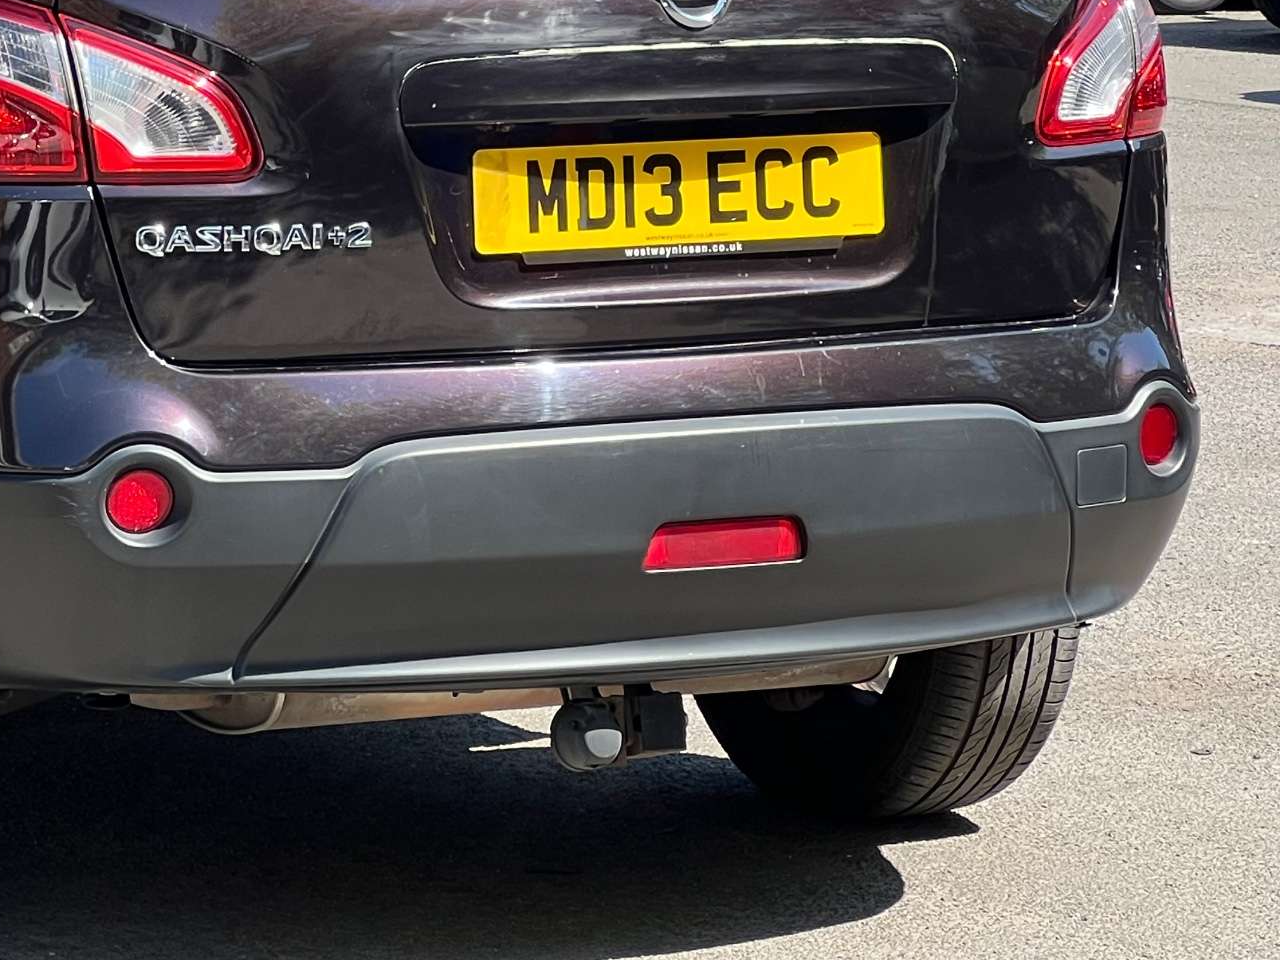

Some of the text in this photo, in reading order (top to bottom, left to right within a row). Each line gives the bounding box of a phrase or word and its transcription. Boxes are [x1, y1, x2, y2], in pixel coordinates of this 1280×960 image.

[526, 145, 841, 233] MD13 ECC
[625, 242, 742, 258] westwaynissan.co.uk
